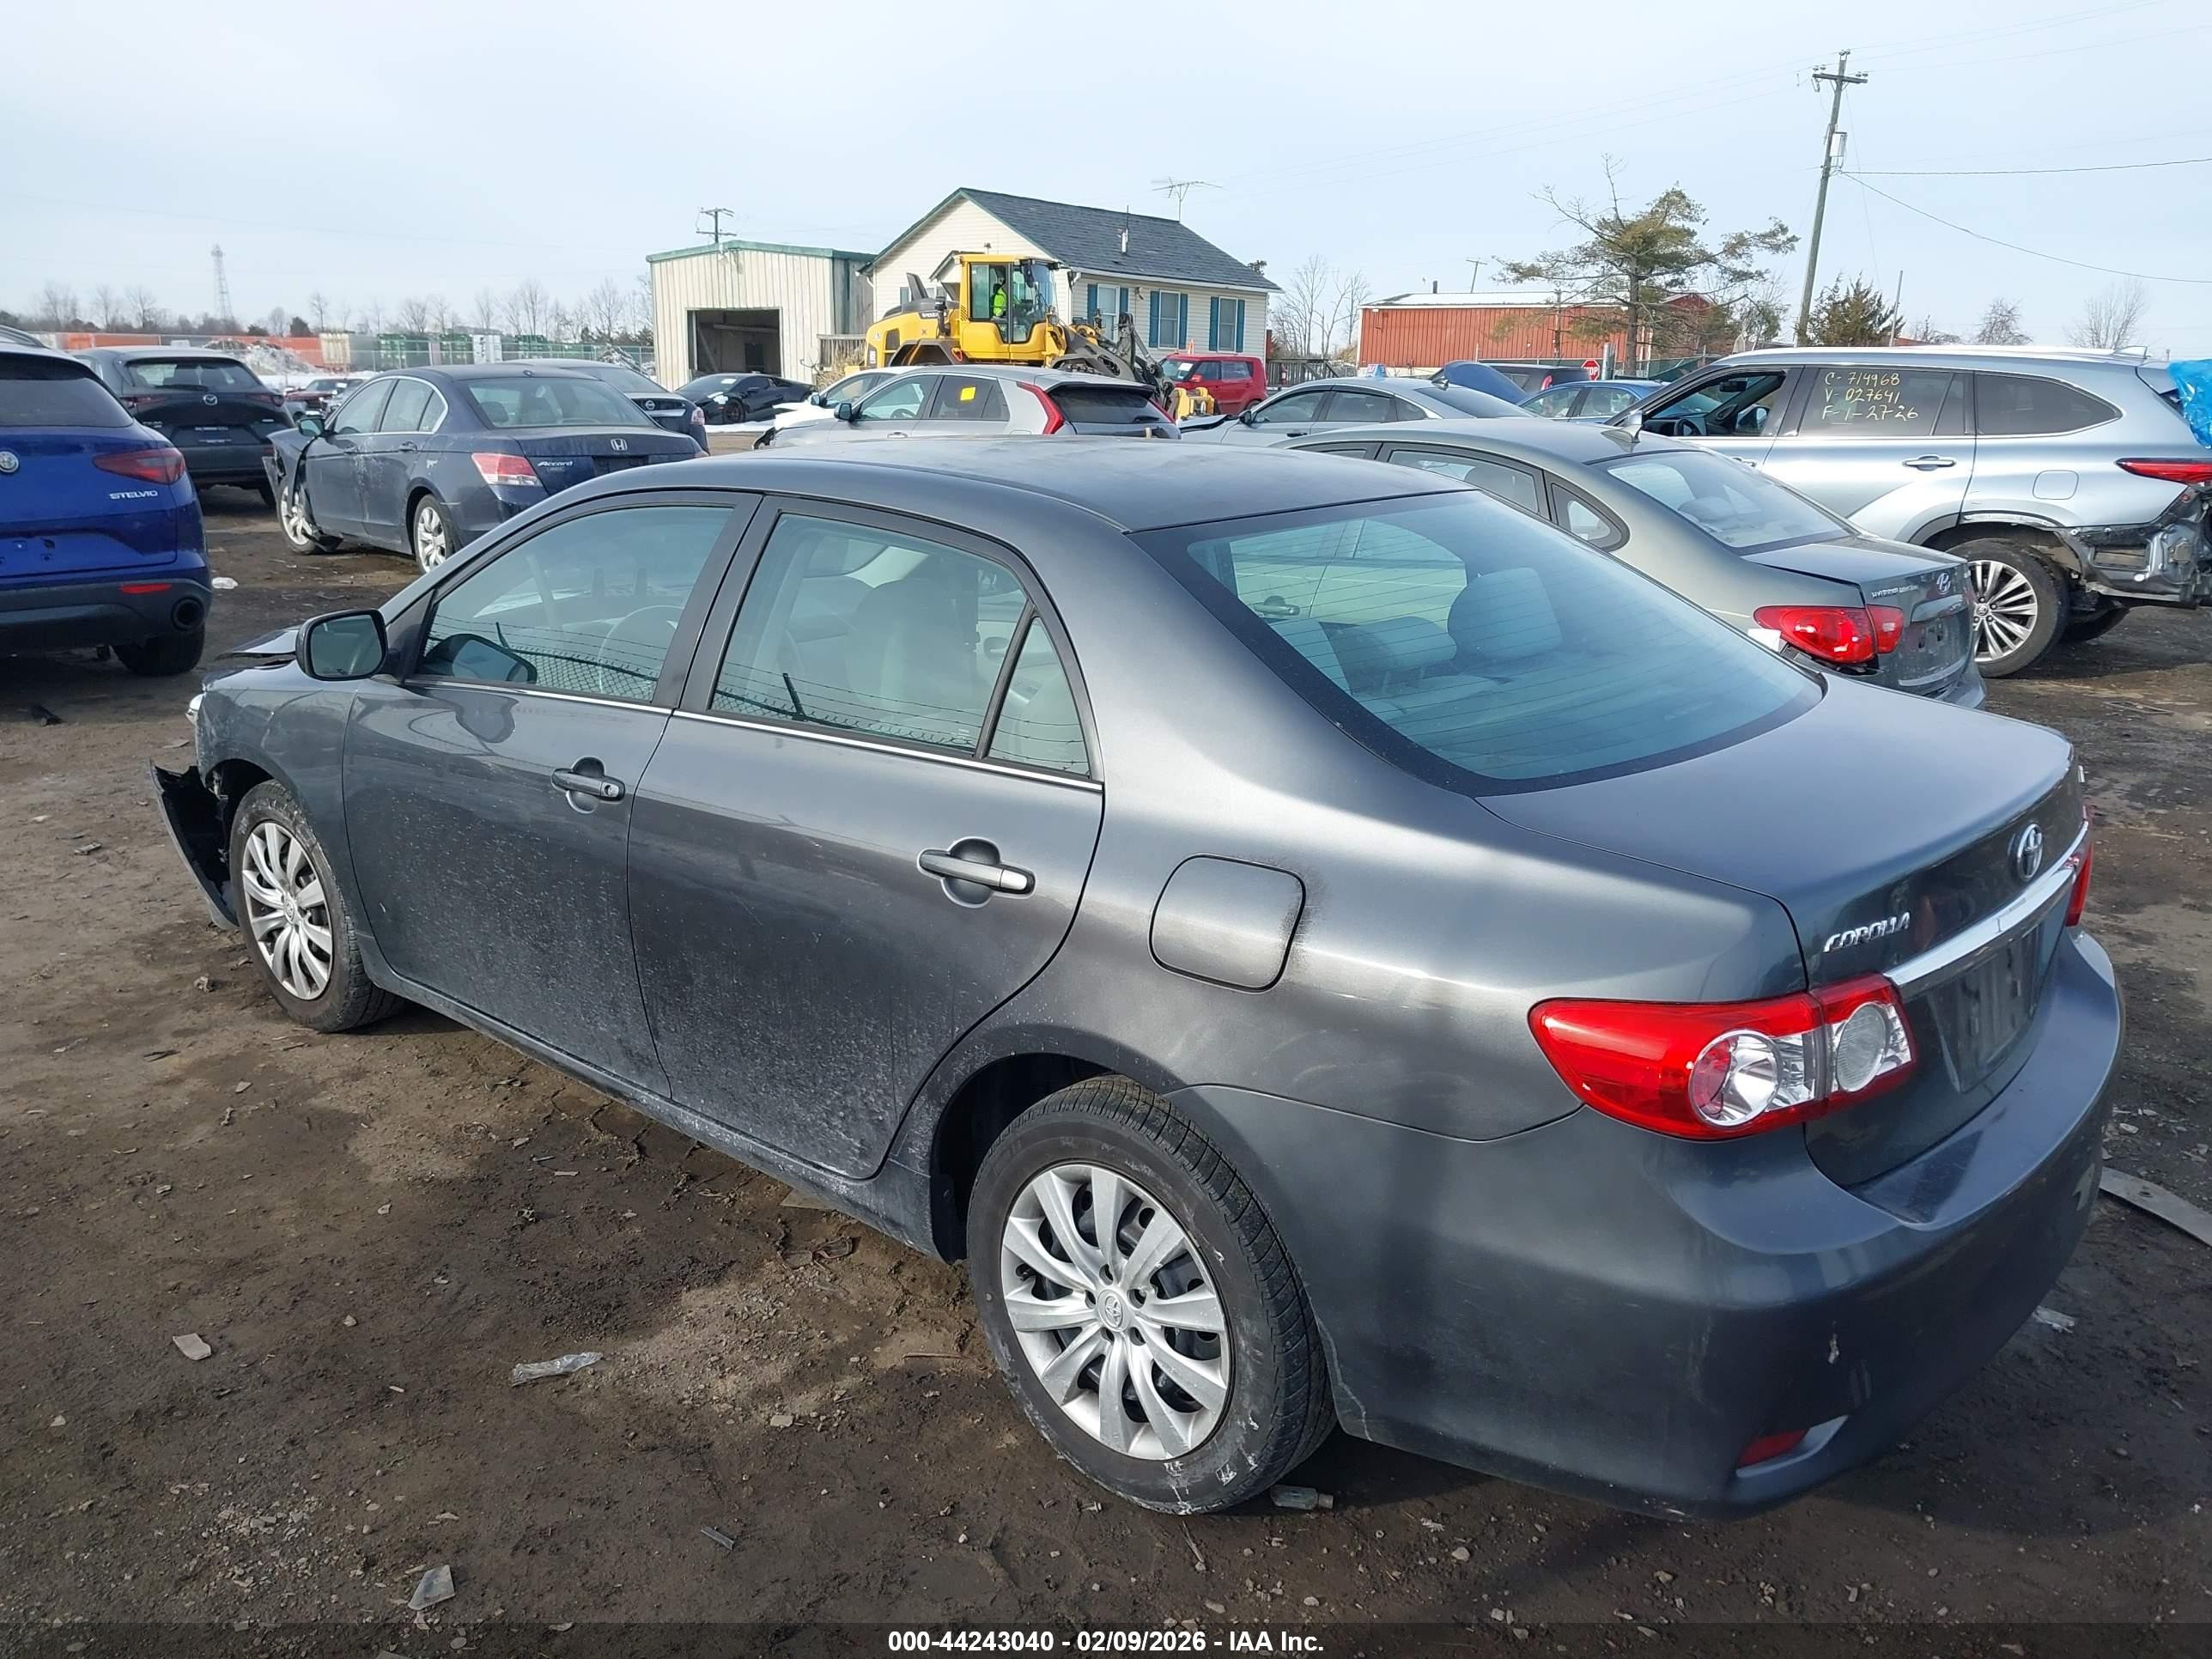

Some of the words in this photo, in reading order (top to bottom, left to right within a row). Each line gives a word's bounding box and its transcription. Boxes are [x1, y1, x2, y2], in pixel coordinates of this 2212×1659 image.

[1847, 372, 1900, 386] 714968
[1845, 388, 1901, 404] 027641
[109, 489, 159, 500] STELVIO
[1822, 911, 1911, 953] COROLLA
